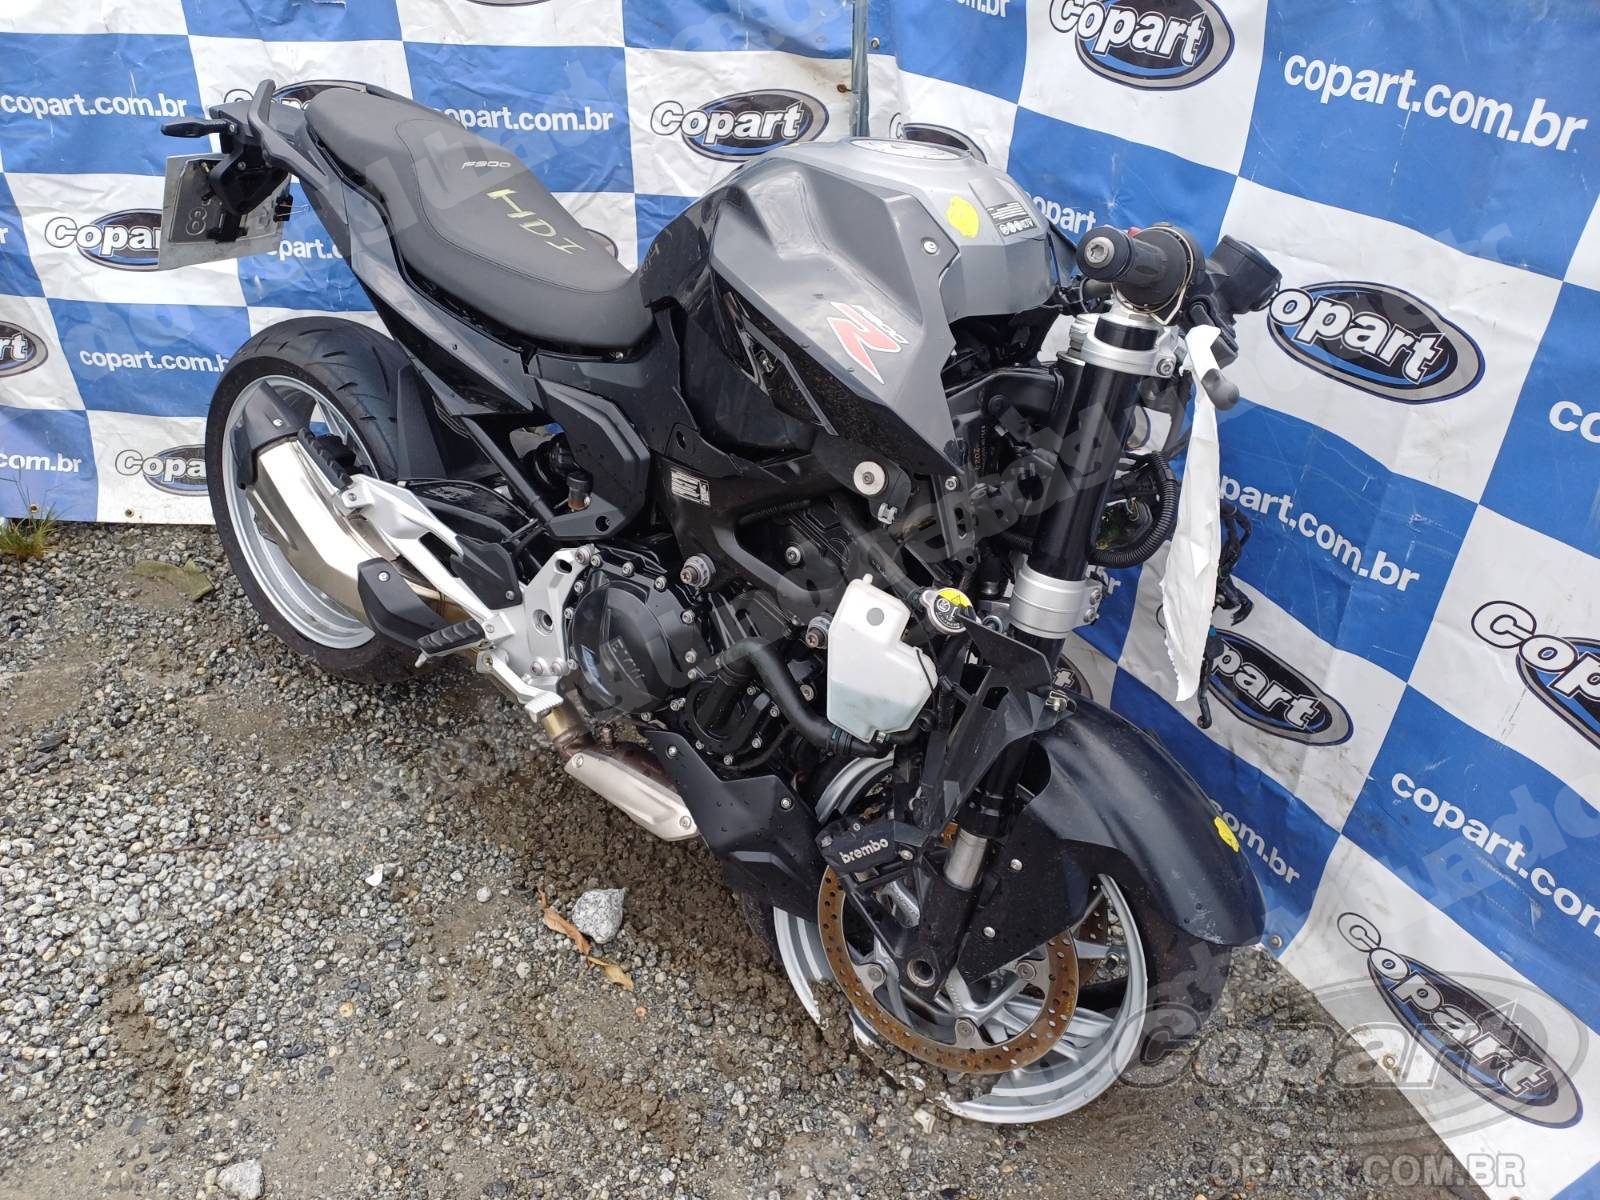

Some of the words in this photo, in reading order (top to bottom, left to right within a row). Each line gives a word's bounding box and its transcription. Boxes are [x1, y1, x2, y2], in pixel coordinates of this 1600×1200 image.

[1049, 0, 1208, 66] Copart
[1, 93, 187, 119] copart.com.br
[433, 106, 614, 131] opart.com.br
[650, 99, 803, 145] Copart
[1283, 53, 1589, 151] copart.com.br
[44, 215, 161, 257] Copa
[1268, 287, 1445, 385] opart
[1219, 474, 1421, 592] part.com.br
[838, 838, 888, 864] brembo
[1336, 911, 1553, 1097] Copart
